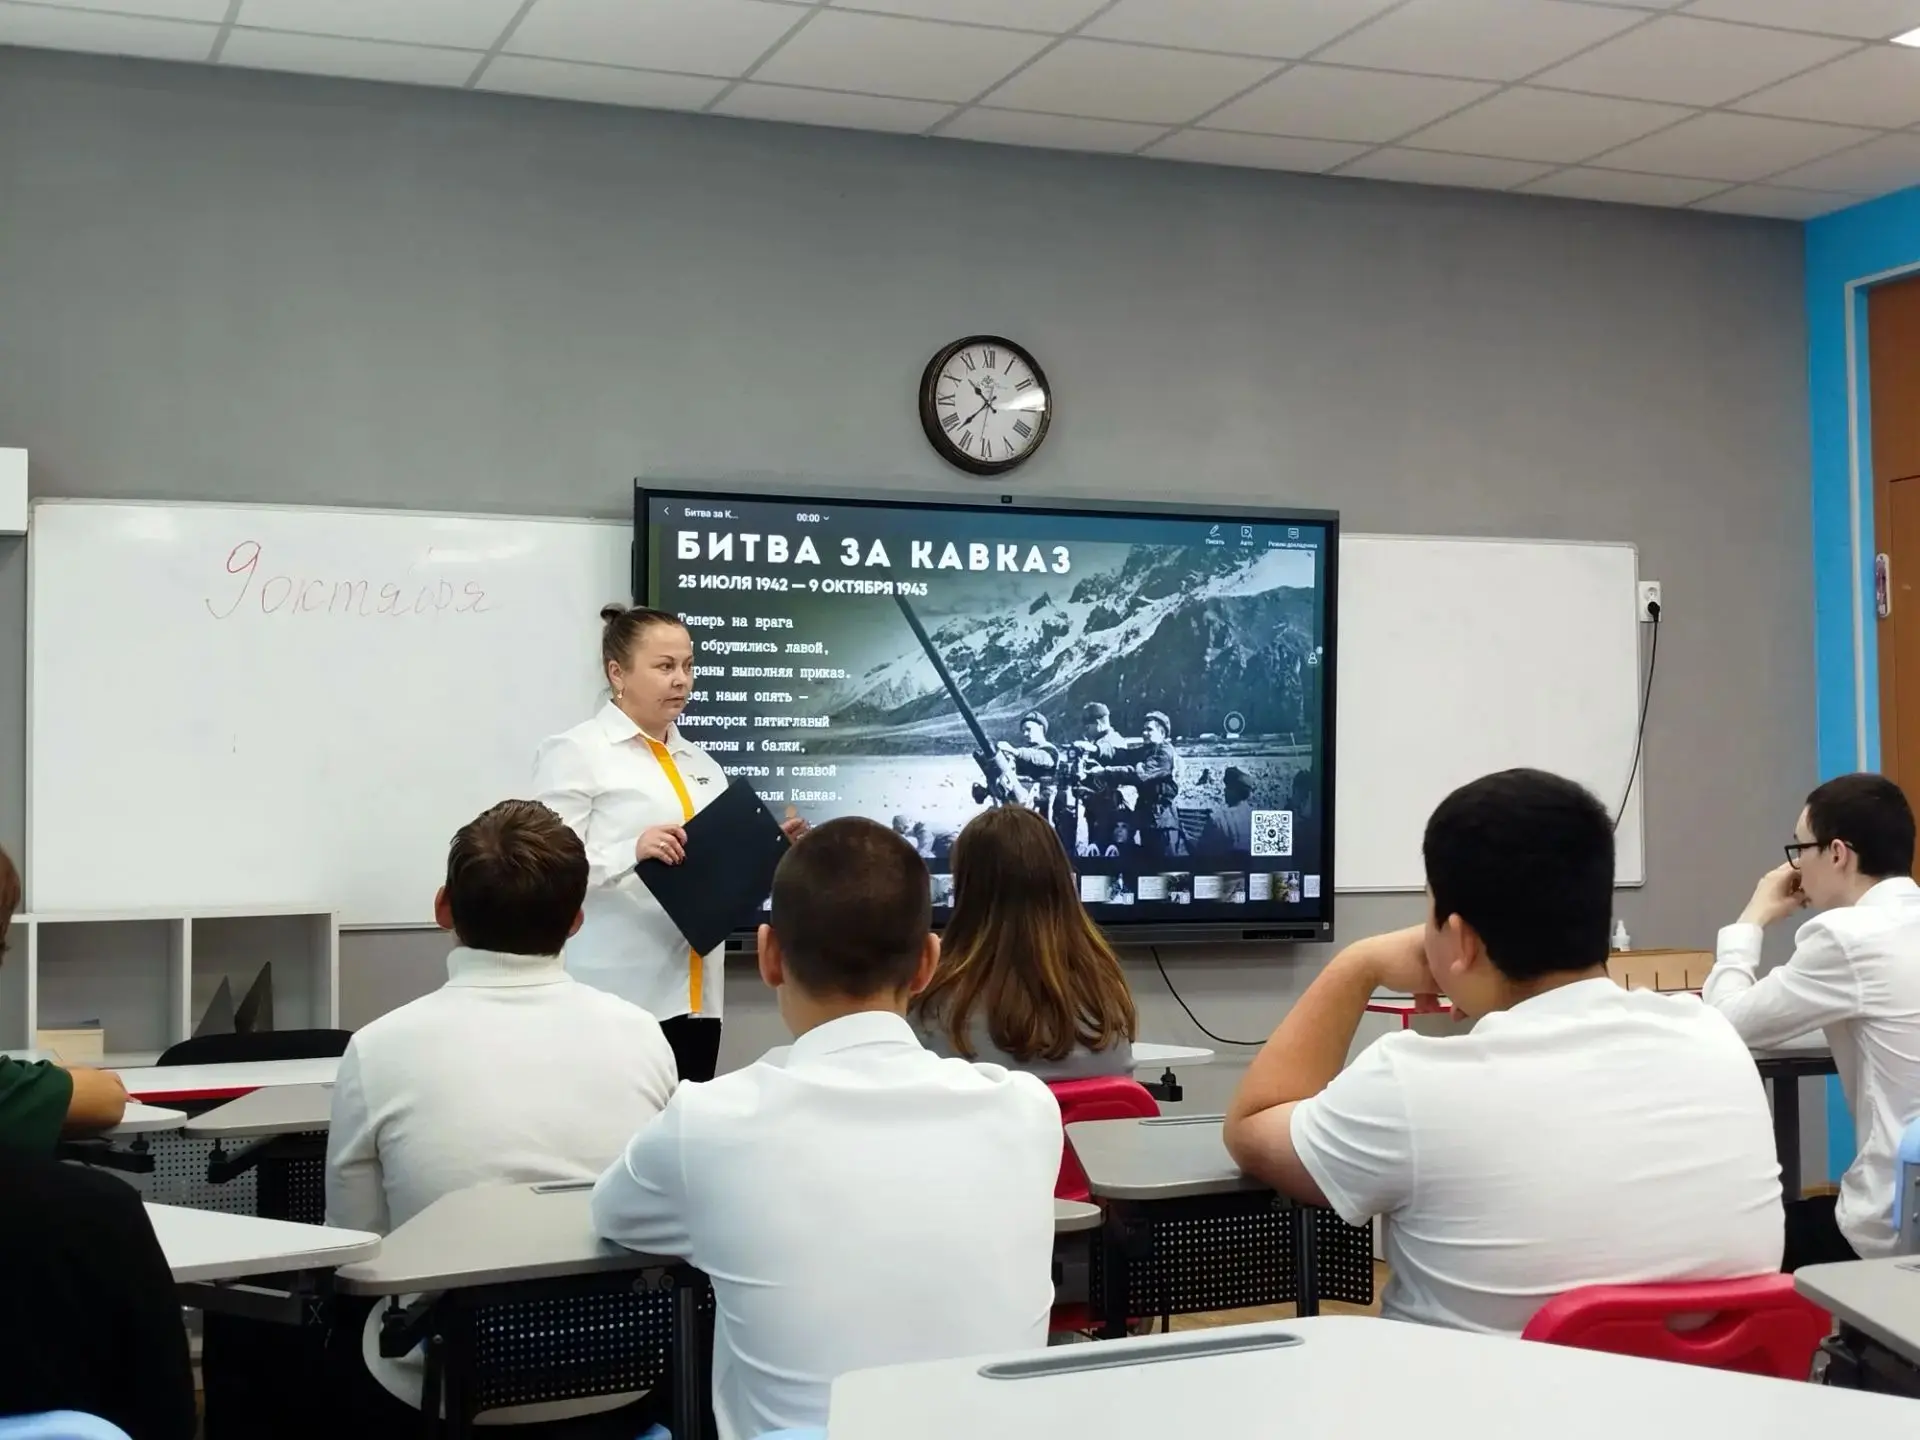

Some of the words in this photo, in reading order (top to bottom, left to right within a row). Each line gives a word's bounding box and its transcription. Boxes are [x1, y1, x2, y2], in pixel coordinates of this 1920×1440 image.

[684, 507, 711, 518] Битва
[713, 510, 723, 518] за
[796, 513, 820, 523] 00:00
[1205, 538, 1225, 546] Писать
[677, 530, 821, 565] БИТВА
[840, 537, 892, 567] ЗА
[911, 540, 1071, 574] КАВКАЗ
[205, 540, 261, 620] 9
[678, 574, 697, 589] 25
[700, 575, 752, 591] ИЮЛЯ
[755, 577, 788, 592] 1942
[809, 579, 819, 592] 9
[821, 579, 893, 595] ОКТЯБРЯ
[896, 581, 928, 596] 1943
[677, 612, 725, 629] Теперь
[732, 616, 748, 627] на
[755, 617, 794, 630] врага
[701, 639, 778, 655] обрушились
[785, 641, 829, 655] лавой,
[691, 666, 725, 679] раны
[731, 666, 793, 678] выполняя
[800, 667, 851, 681] приказ.
[716, 691, 748, 702] нами
[754, 691, 792, 703] опять
[677, 713, 747, 729] Пятигорск
[754, 715, 830, 728] пятиглавый
[746, 741, 755, 751] и
[761, 740, 806, 754] балки,
[723, 766, 770, 776] честью
[776, 766, 785, 776] и
[791, 765, 837, 777] славой
[791, 789, 842, 801] Кавказ.
